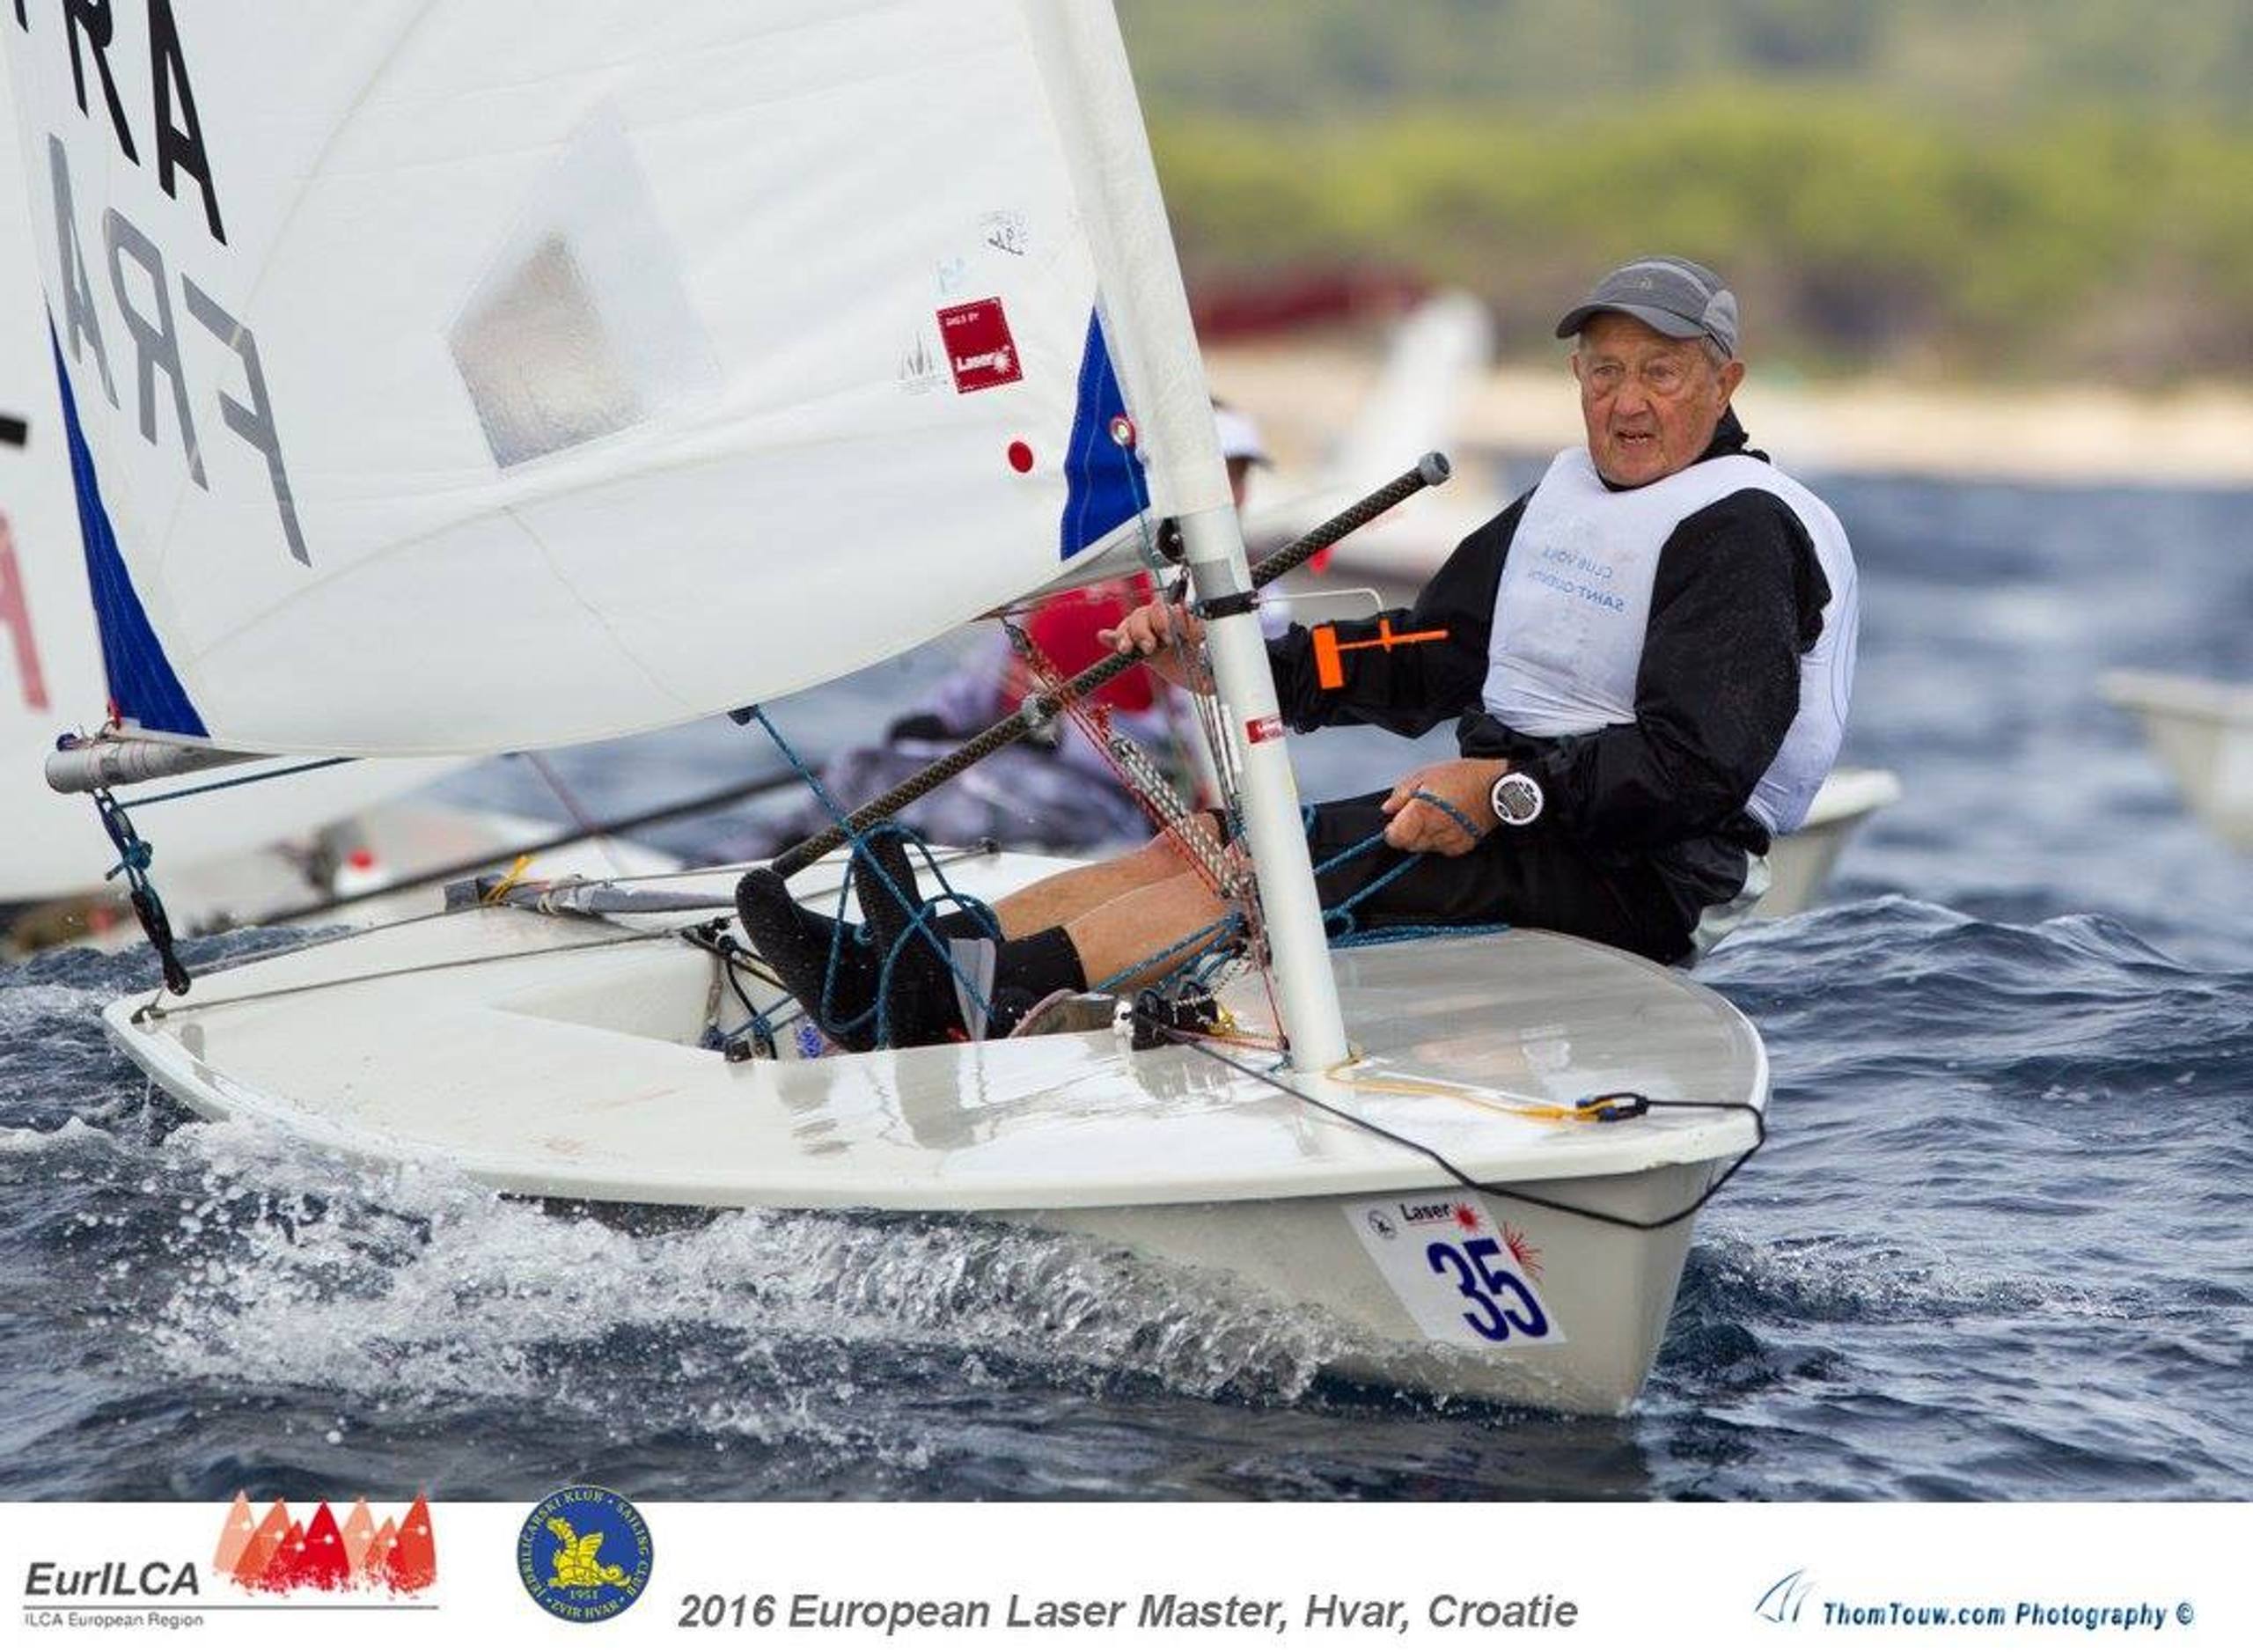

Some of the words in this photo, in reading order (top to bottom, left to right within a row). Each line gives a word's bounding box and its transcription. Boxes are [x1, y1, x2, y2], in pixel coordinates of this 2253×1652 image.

[15, 0, 227, 246] RA
[1399, 1203, 1450, 1222] Laser
[1427, 1237, 1548, 1342] 35
